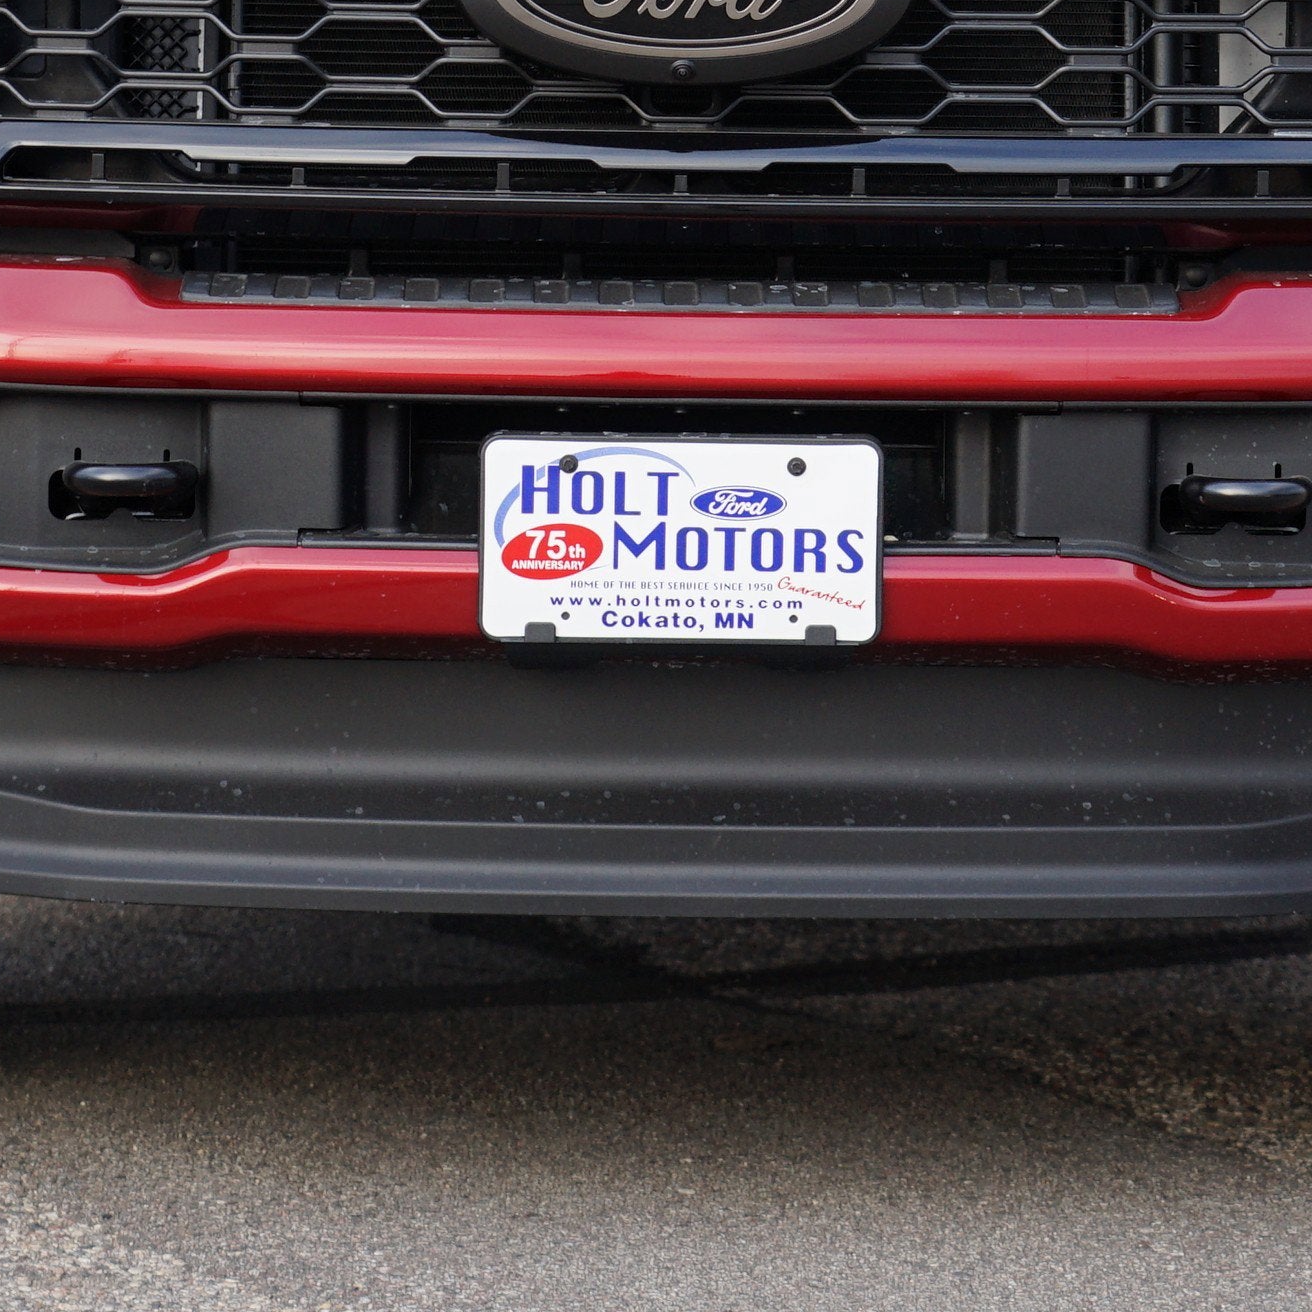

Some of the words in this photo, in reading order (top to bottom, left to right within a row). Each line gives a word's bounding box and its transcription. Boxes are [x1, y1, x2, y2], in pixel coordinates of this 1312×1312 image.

[520, 464, 680, 517] HOLT
[707, 489, 768, 517] Ford
[525, 529, 587, 560] 75th
[612, 520, 865, 575] MOTORS
[511, 559, 585, 571] ANNIVERSARY
[570, 580, 600, 589] HOME
[603, 580, 615, 589] OF
[619, 580, 637, 590] THE
[640, 581, 664, 590] BEST
[667, 581, 710, 591] SERVICE
[713, 582, 744, 592] SINCE
[748, 582, 774, 592] 1950
[776, 576, 866, 611] Guaranteed
[550, 594, 803, 610] www.holtmotors.com
[601, 610, 706, 633] Cokato,
[714, 612, 755, 630] MN
